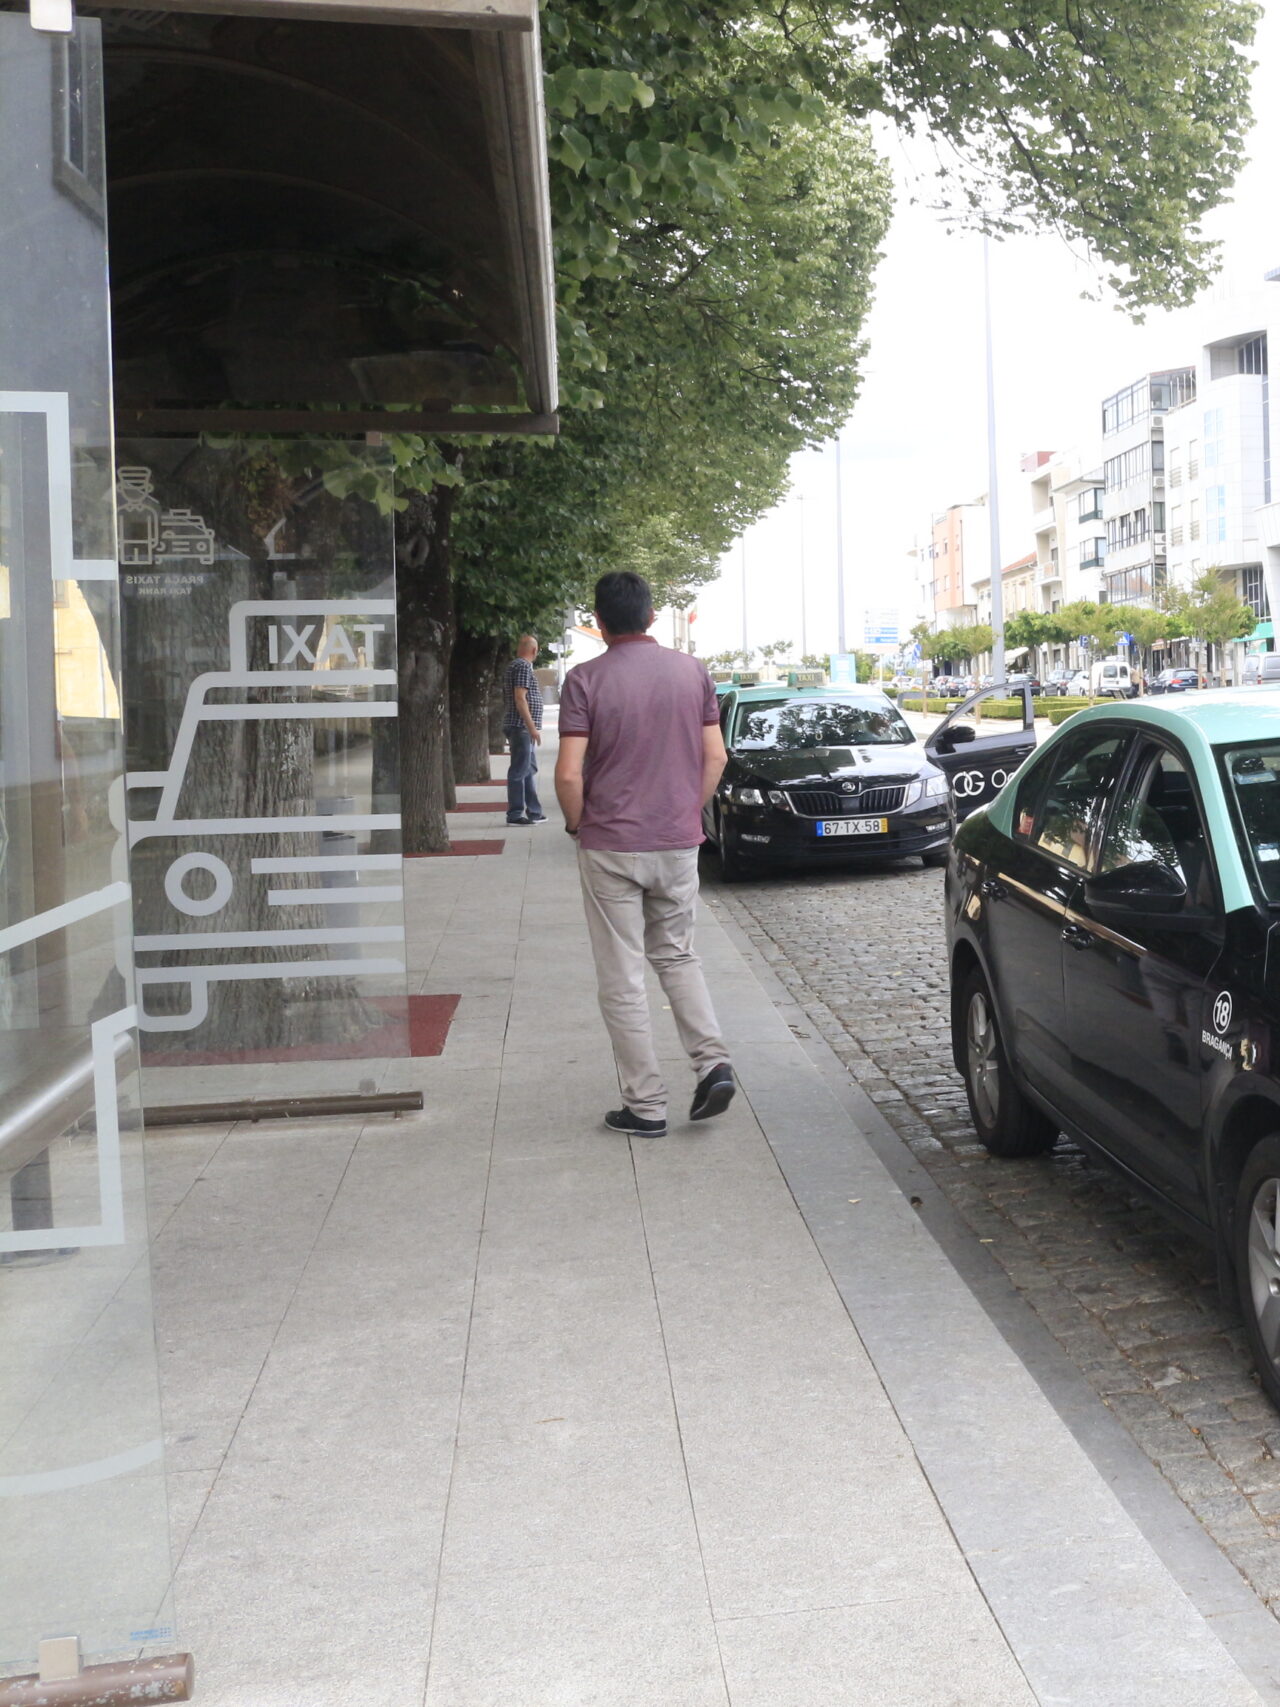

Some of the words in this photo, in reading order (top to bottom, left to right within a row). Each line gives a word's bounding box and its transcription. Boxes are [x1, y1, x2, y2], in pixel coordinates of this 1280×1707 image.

[798, 674, 814, 682] TAXI
[1216, 1000, 1229, 1027] 18
[1202, 1030, 1233, 1060] BRAGANÇA
